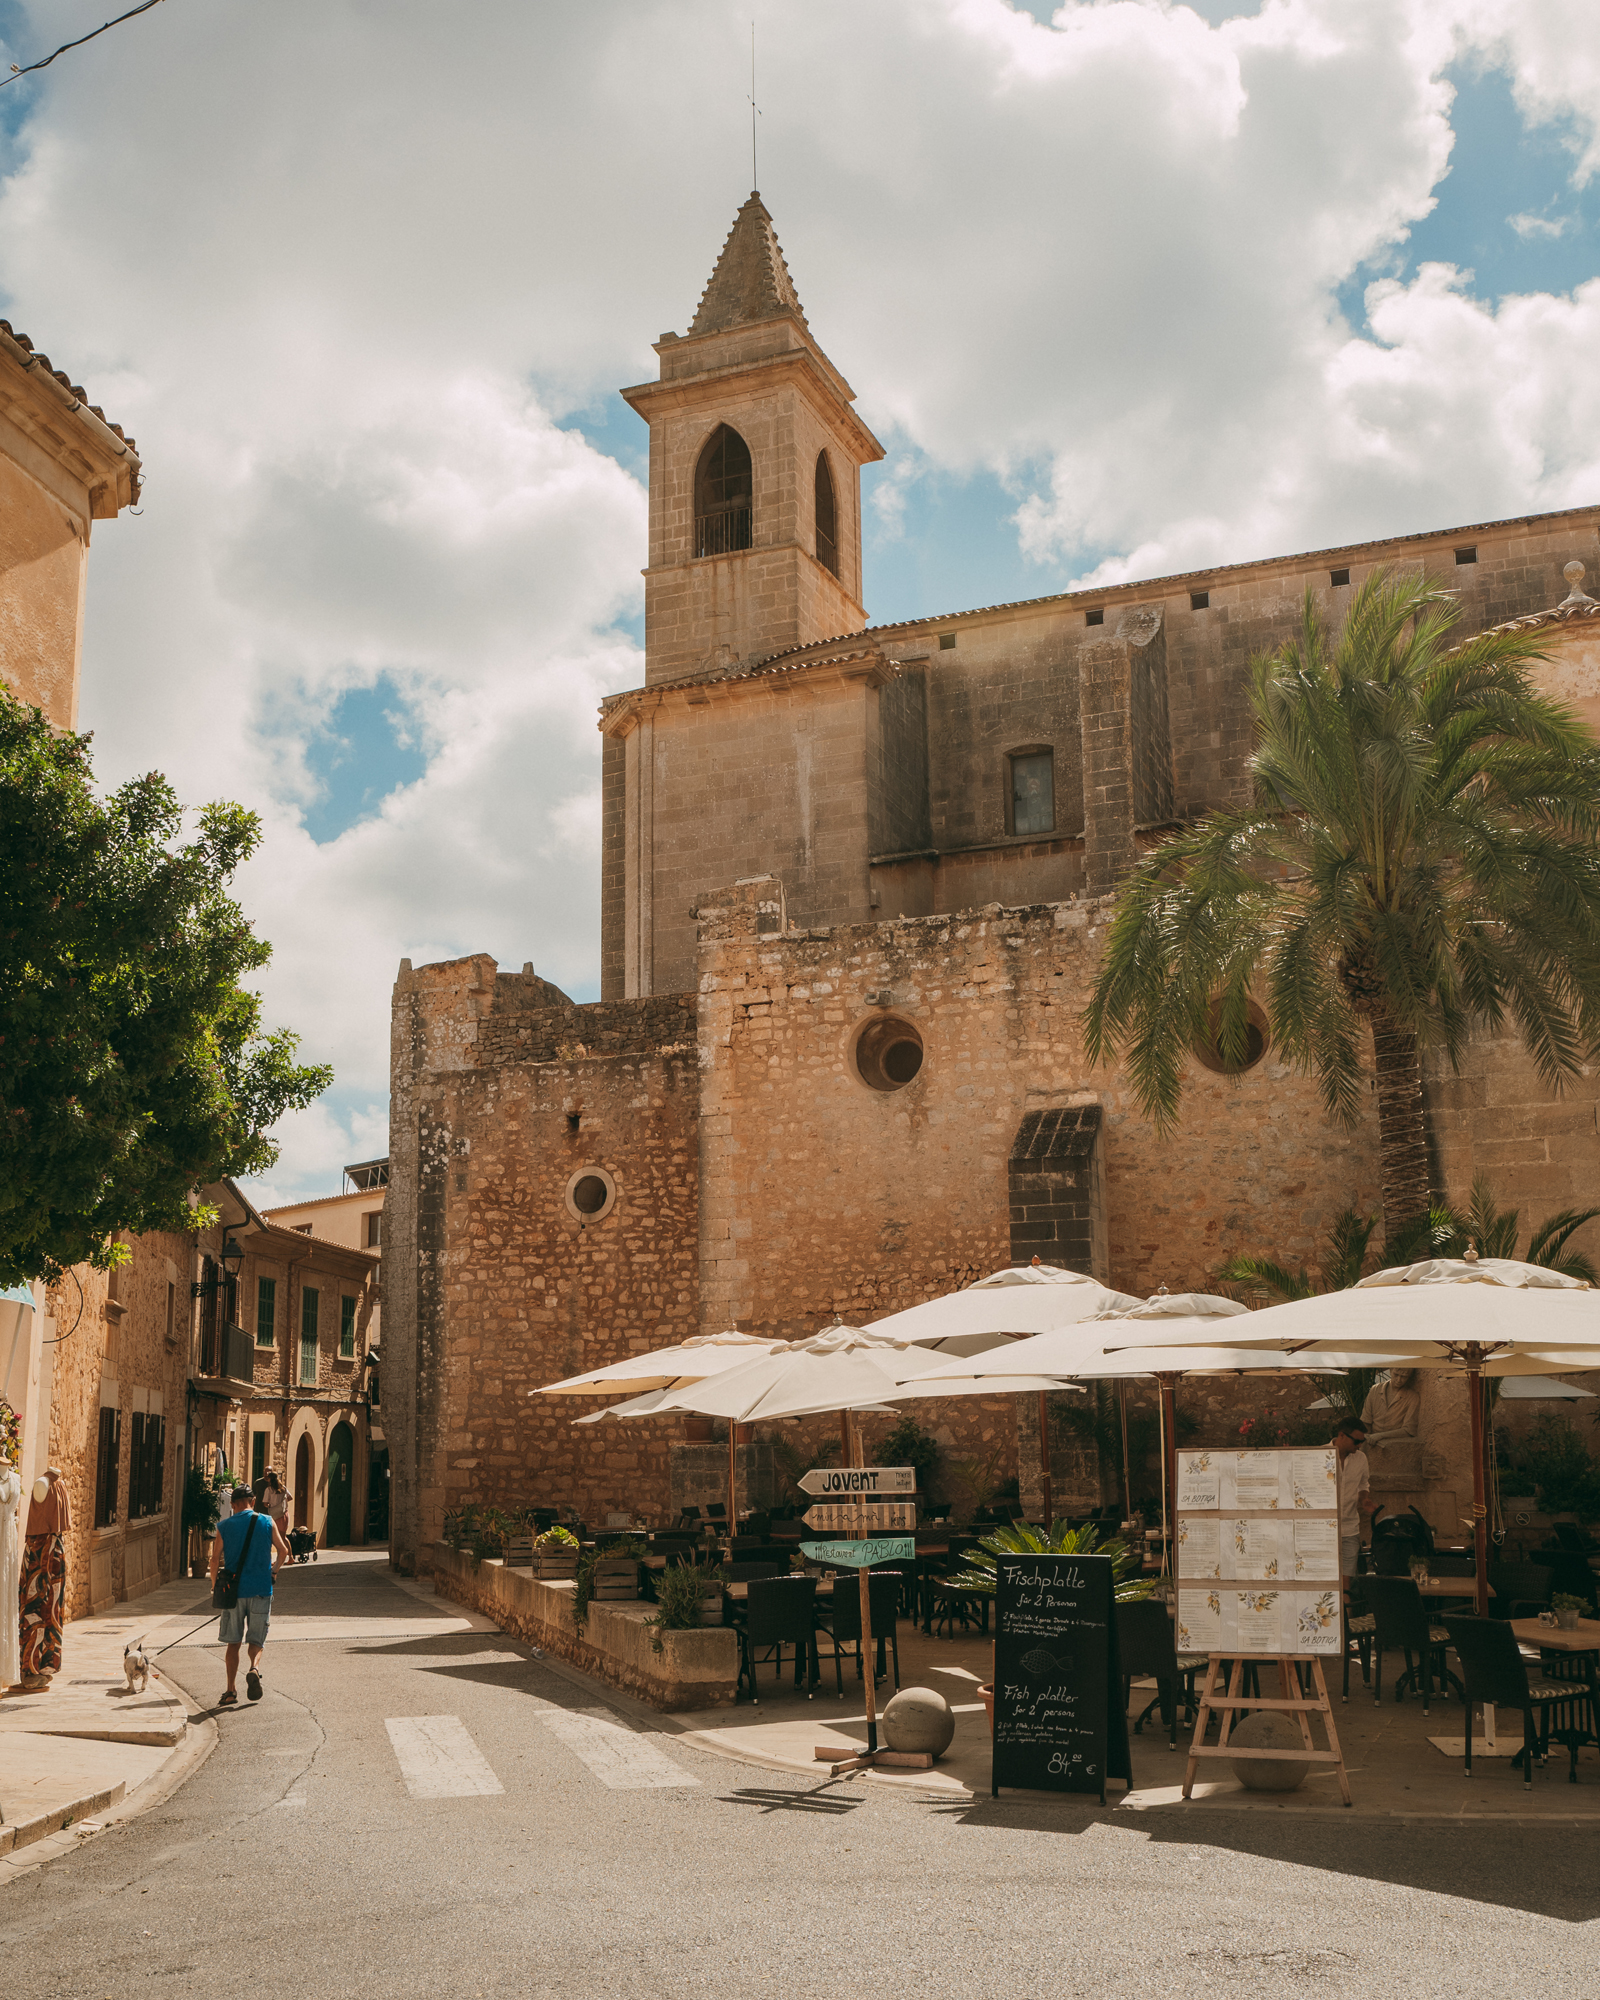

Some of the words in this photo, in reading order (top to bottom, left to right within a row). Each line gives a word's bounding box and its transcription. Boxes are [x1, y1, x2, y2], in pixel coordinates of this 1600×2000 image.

[862, 1540, 903, 1561] PABLO
[1003, 1565, 1086, 1594] Fischplatte
[1016, 1593, 1031, 1607] für
[1034, 1595, 1042, 1606] 2
[1046, 1595, 1077, 1607] Personen
[1300, 1636, 1310, 1644] SA
[1004, 1685, 1029, 1700] Fish
[1036, 1686, 1078, 1705] platter
[1012, 1705, 1026, 1716] for
[1028, 1705, 1036, 1715] 2
[1041, 1710, 1075, 1722] persons
[1086, 1764, 1096, 1775] €
